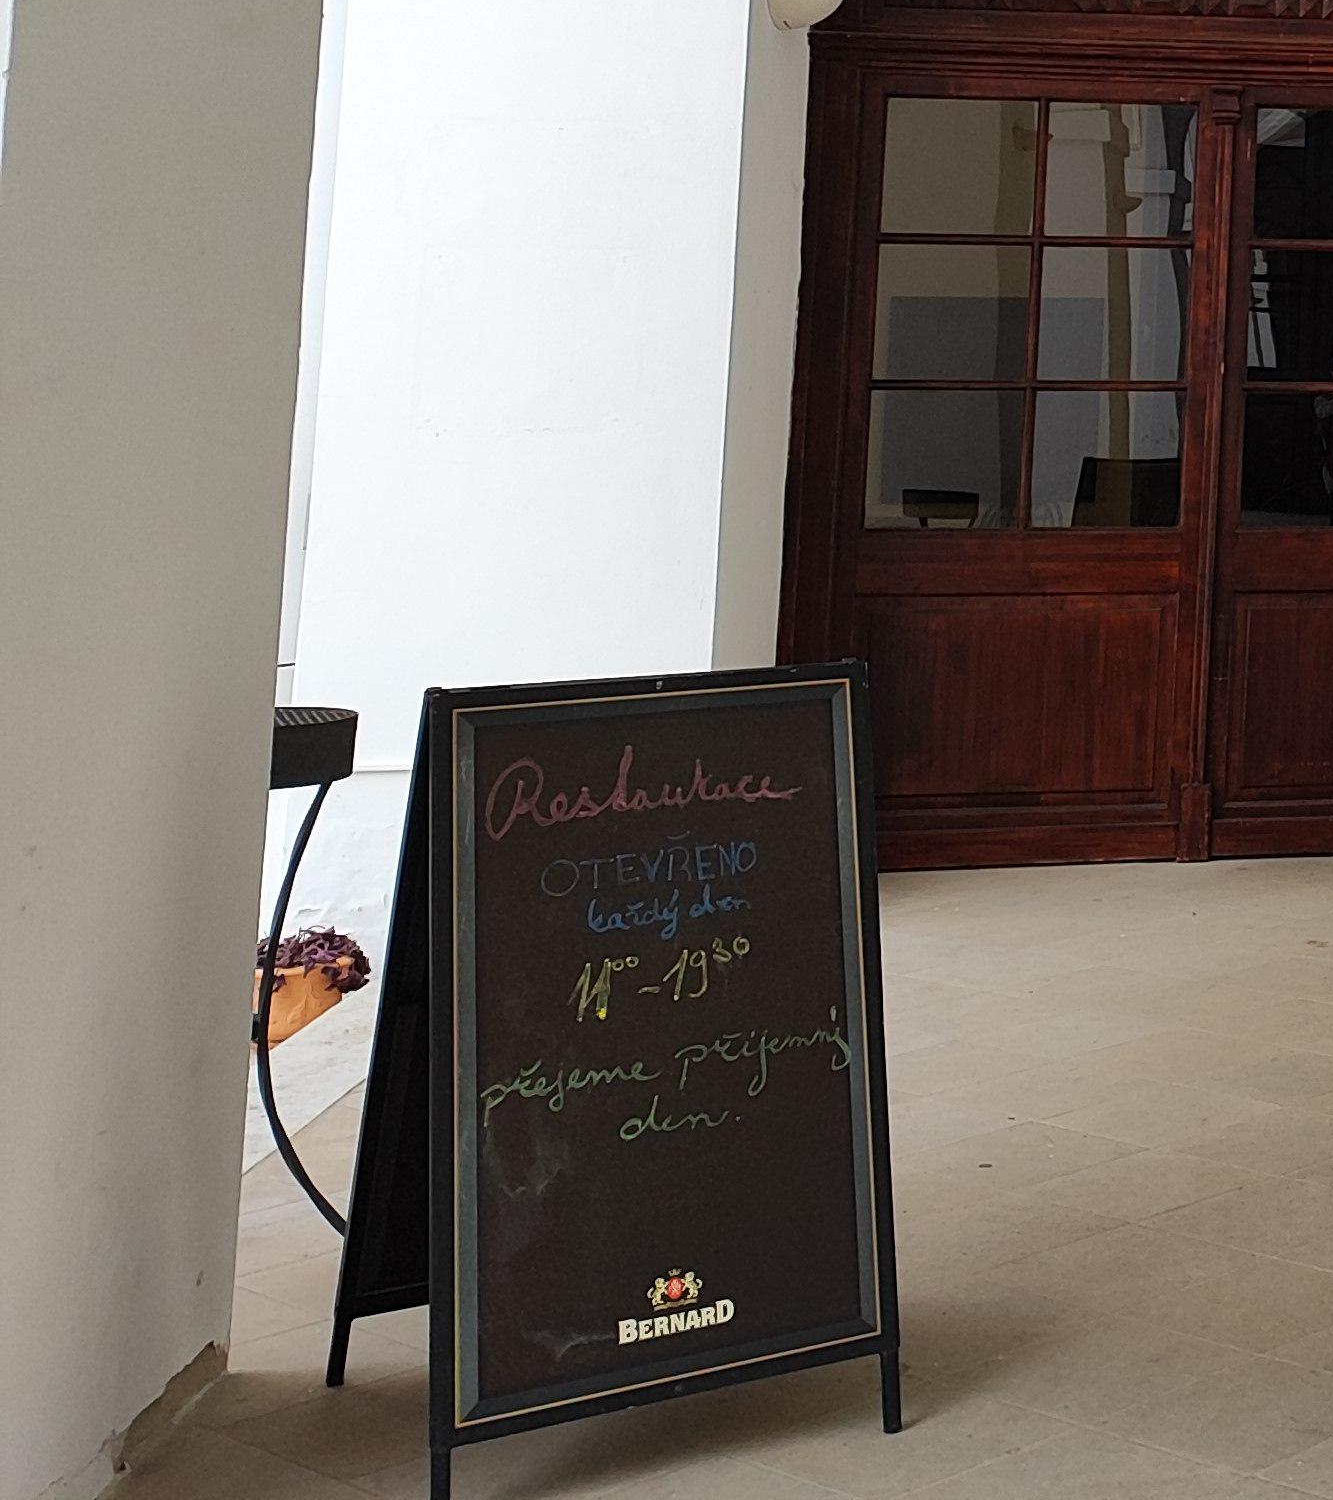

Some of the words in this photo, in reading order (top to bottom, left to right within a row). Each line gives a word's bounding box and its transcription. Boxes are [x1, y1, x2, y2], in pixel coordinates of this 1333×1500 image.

[485, 744, 801, 840] Restaurace
[541, 830, 757, 896] OTEVŘENO
[480, 1059, 661, 1127] přejeme
[618, 1298, 735, 1345] BERNARD
